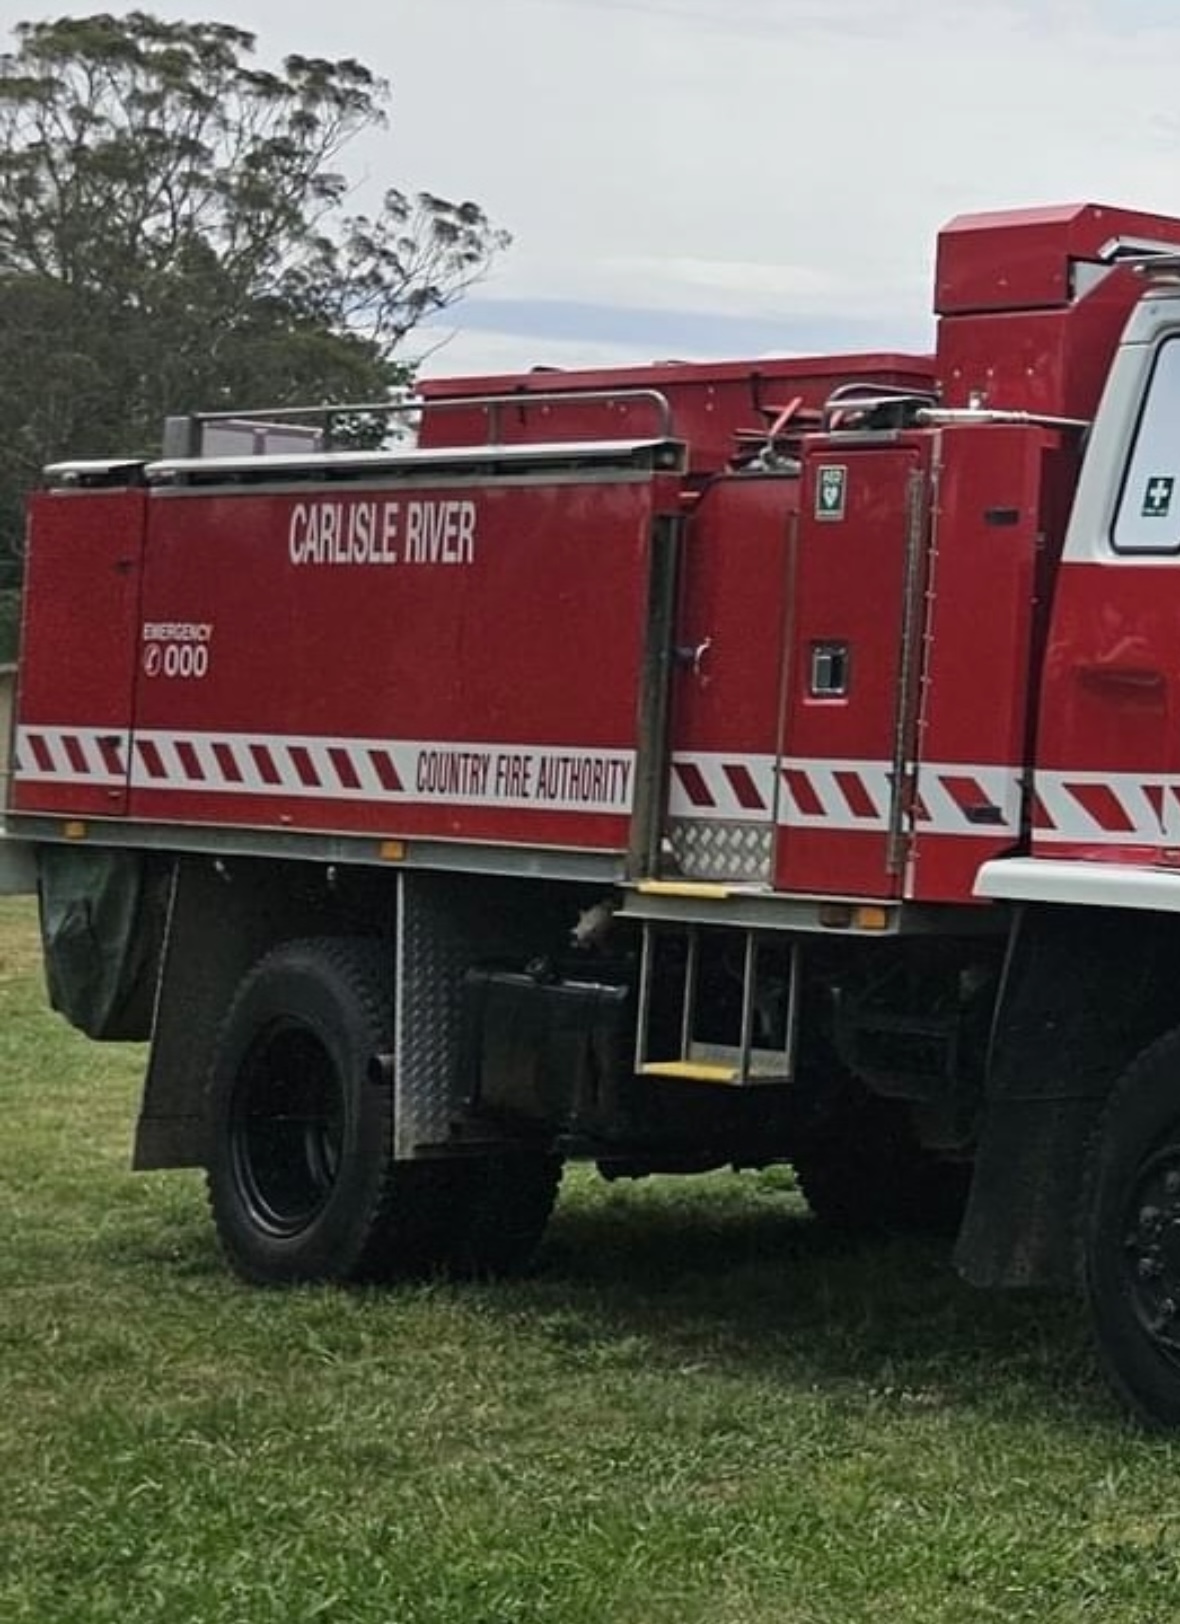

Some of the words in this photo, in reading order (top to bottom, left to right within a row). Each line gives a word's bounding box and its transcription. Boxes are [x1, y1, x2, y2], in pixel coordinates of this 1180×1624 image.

[289, 503, 399, 564] CARLISLE
[405, 501, 476, 563] RIVER
[143, 622, 214, 641] EMERGENCY
[164, 644, 208, 678] 000
[416, 750, 490, 796] COUNTRY
[496, 754, 533, 798] FIRE
[537, 756, 631, 803] AUTHORITY
